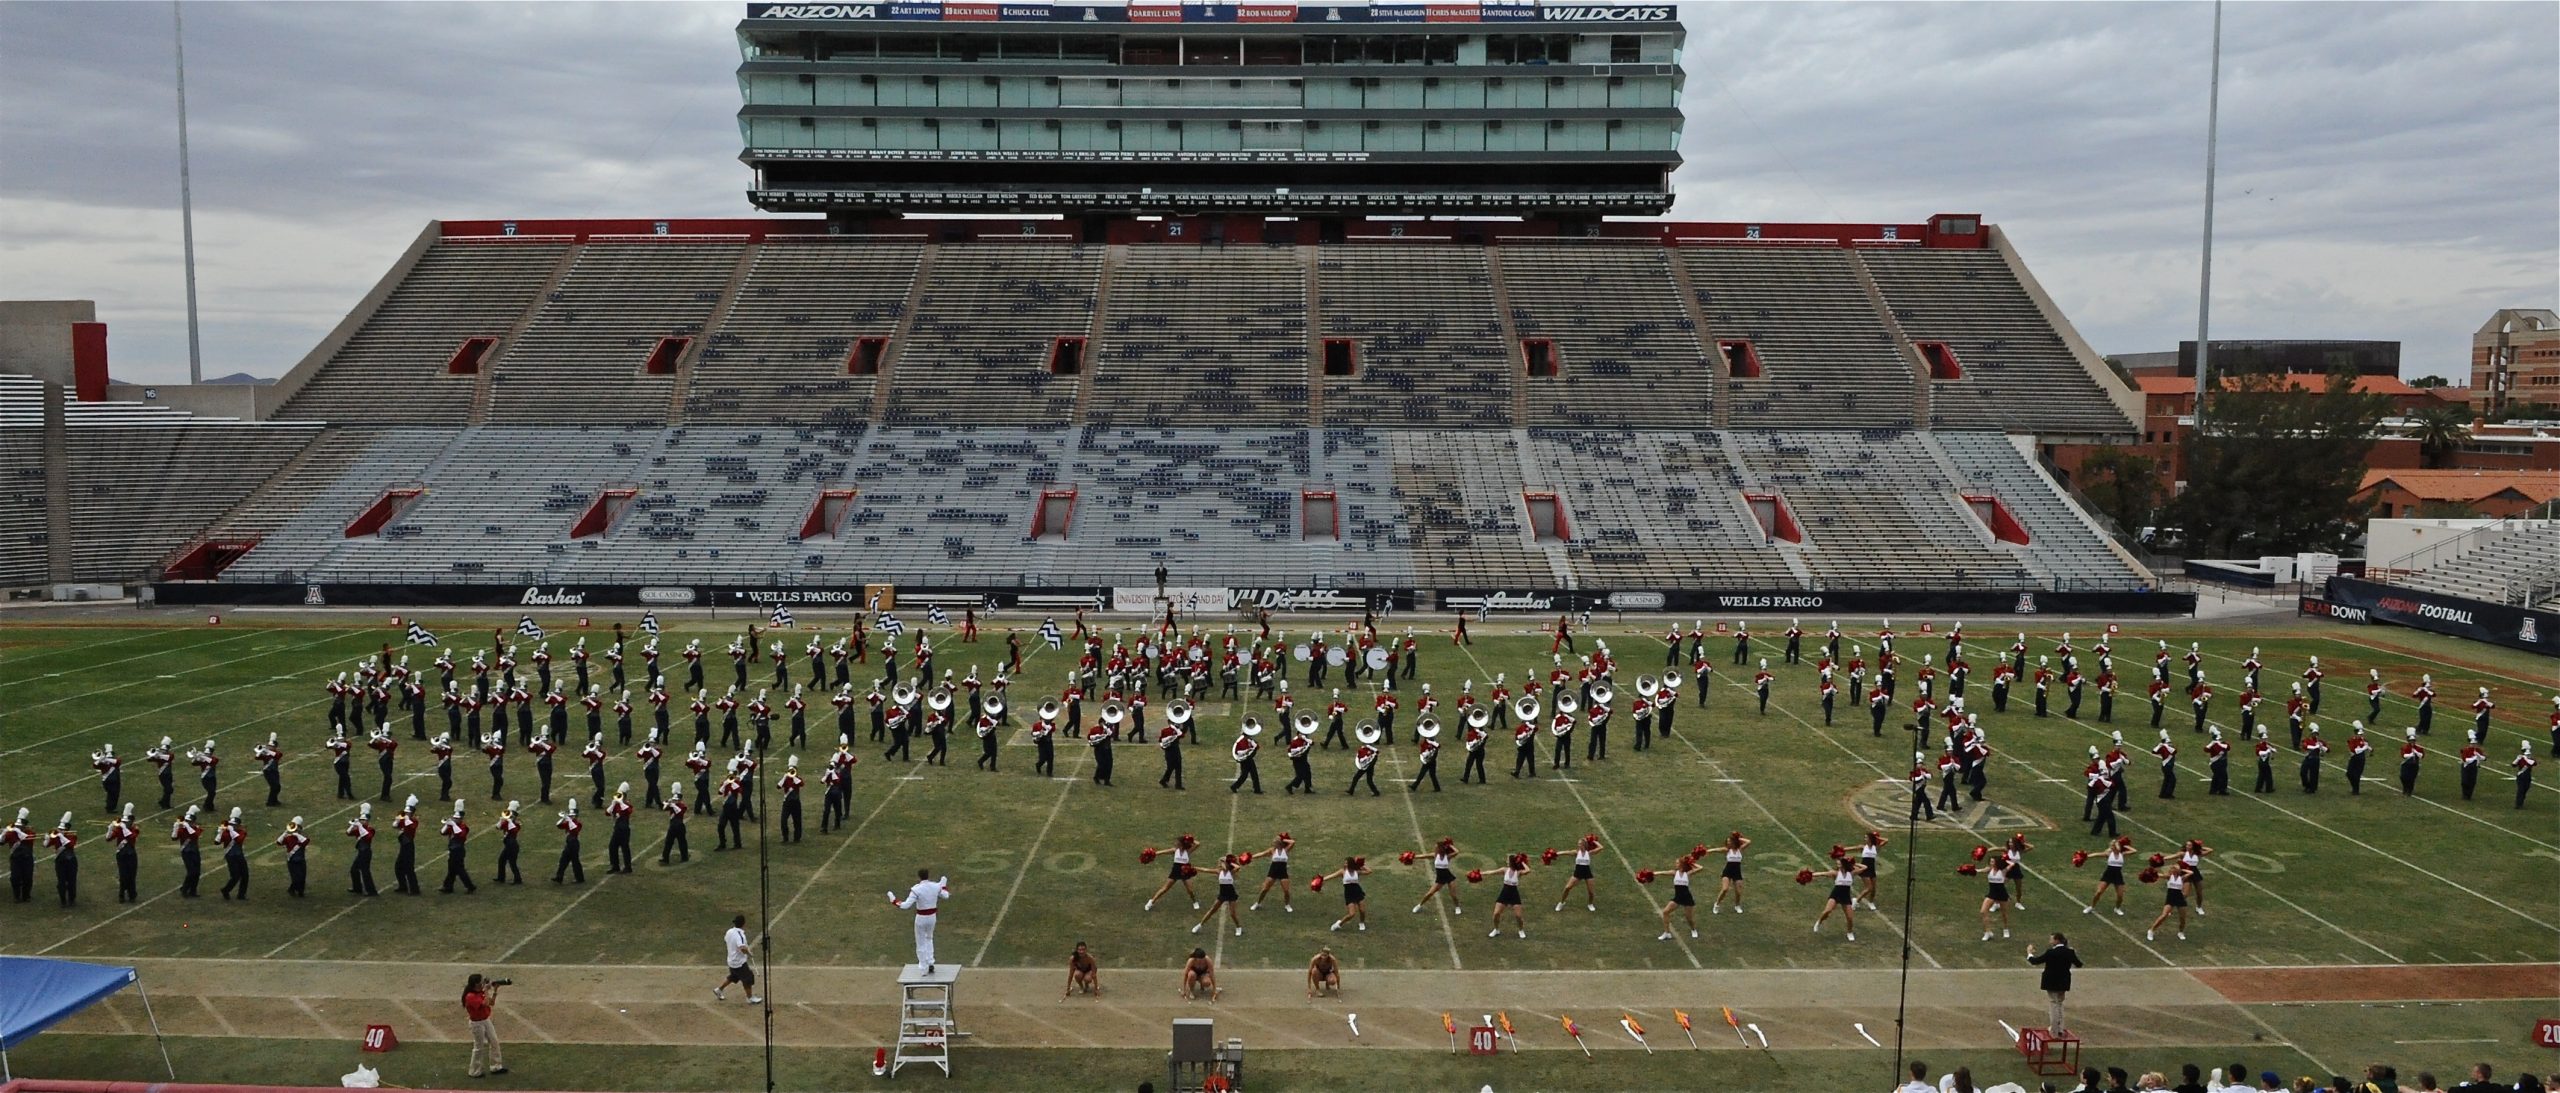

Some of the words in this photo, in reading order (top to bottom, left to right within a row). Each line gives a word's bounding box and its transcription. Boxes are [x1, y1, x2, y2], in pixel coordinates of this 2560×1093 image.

[760, 6, 876, 18] ARIZONA
[891, 6, 899, 14] 22
[900, 7, 912, 15] ART
[913, 7, 940, 15] LUPPINO
[953, 7, 972, 15] RICKY
[973, 7, 998, 15] HUNLEY
[1008, 8, 1030, 16] CHUCK
[1032, 8, 1049, 16] CECIL
[1260, 9, 1290, 17] WALDROP
[1370, 8, 1378, 17] 28
[1379, 9, 1393, 17] STEVE
[1394, 9, 1425, 17] McLAUGHLIN
[1432, 9, 1448, 17] CHRIS
[1450, 9, 1480, 17] McALISTER
[1487, 9, 1512, 17] ANTOINE
[1514, 9, 1535, 17] CASON
[1543, 7, 1669, 21] WILDCATS
[505, 227, 515, 236] 17
[656, 226, 667, 235] 18
[828, 226, 839, 235] 19
[1023, 226, 1036, 236] 20
[1170, 227, 1181, 236] 21
[1391, 227, 1403, 237] 22
[1587, 228, 1599, 238] 23
[1747, 230, 1760, 239] 24
[1883, 231, 1896, 240] 25
[146, 390, 156, 398] 16
[520, 587, 585, 605] Bashas'
[748, 591, 800, 602] WELLS
[804, 591, 852, 602] FARGO
[1116, 595, 1150, 604] UNIVERSITY
[1212, 595, 1224, 604] DAY
[1719, 596, 1770, 607] WELLS
[1774, 596, 1823, 607] FARGO
[366, 1029, 384, 1048] 40
[926, 1029, 942, 1046] 50
[2542, 1025, 2560, 1044] 20
[1473, 1031, 1491, 1050] 40
